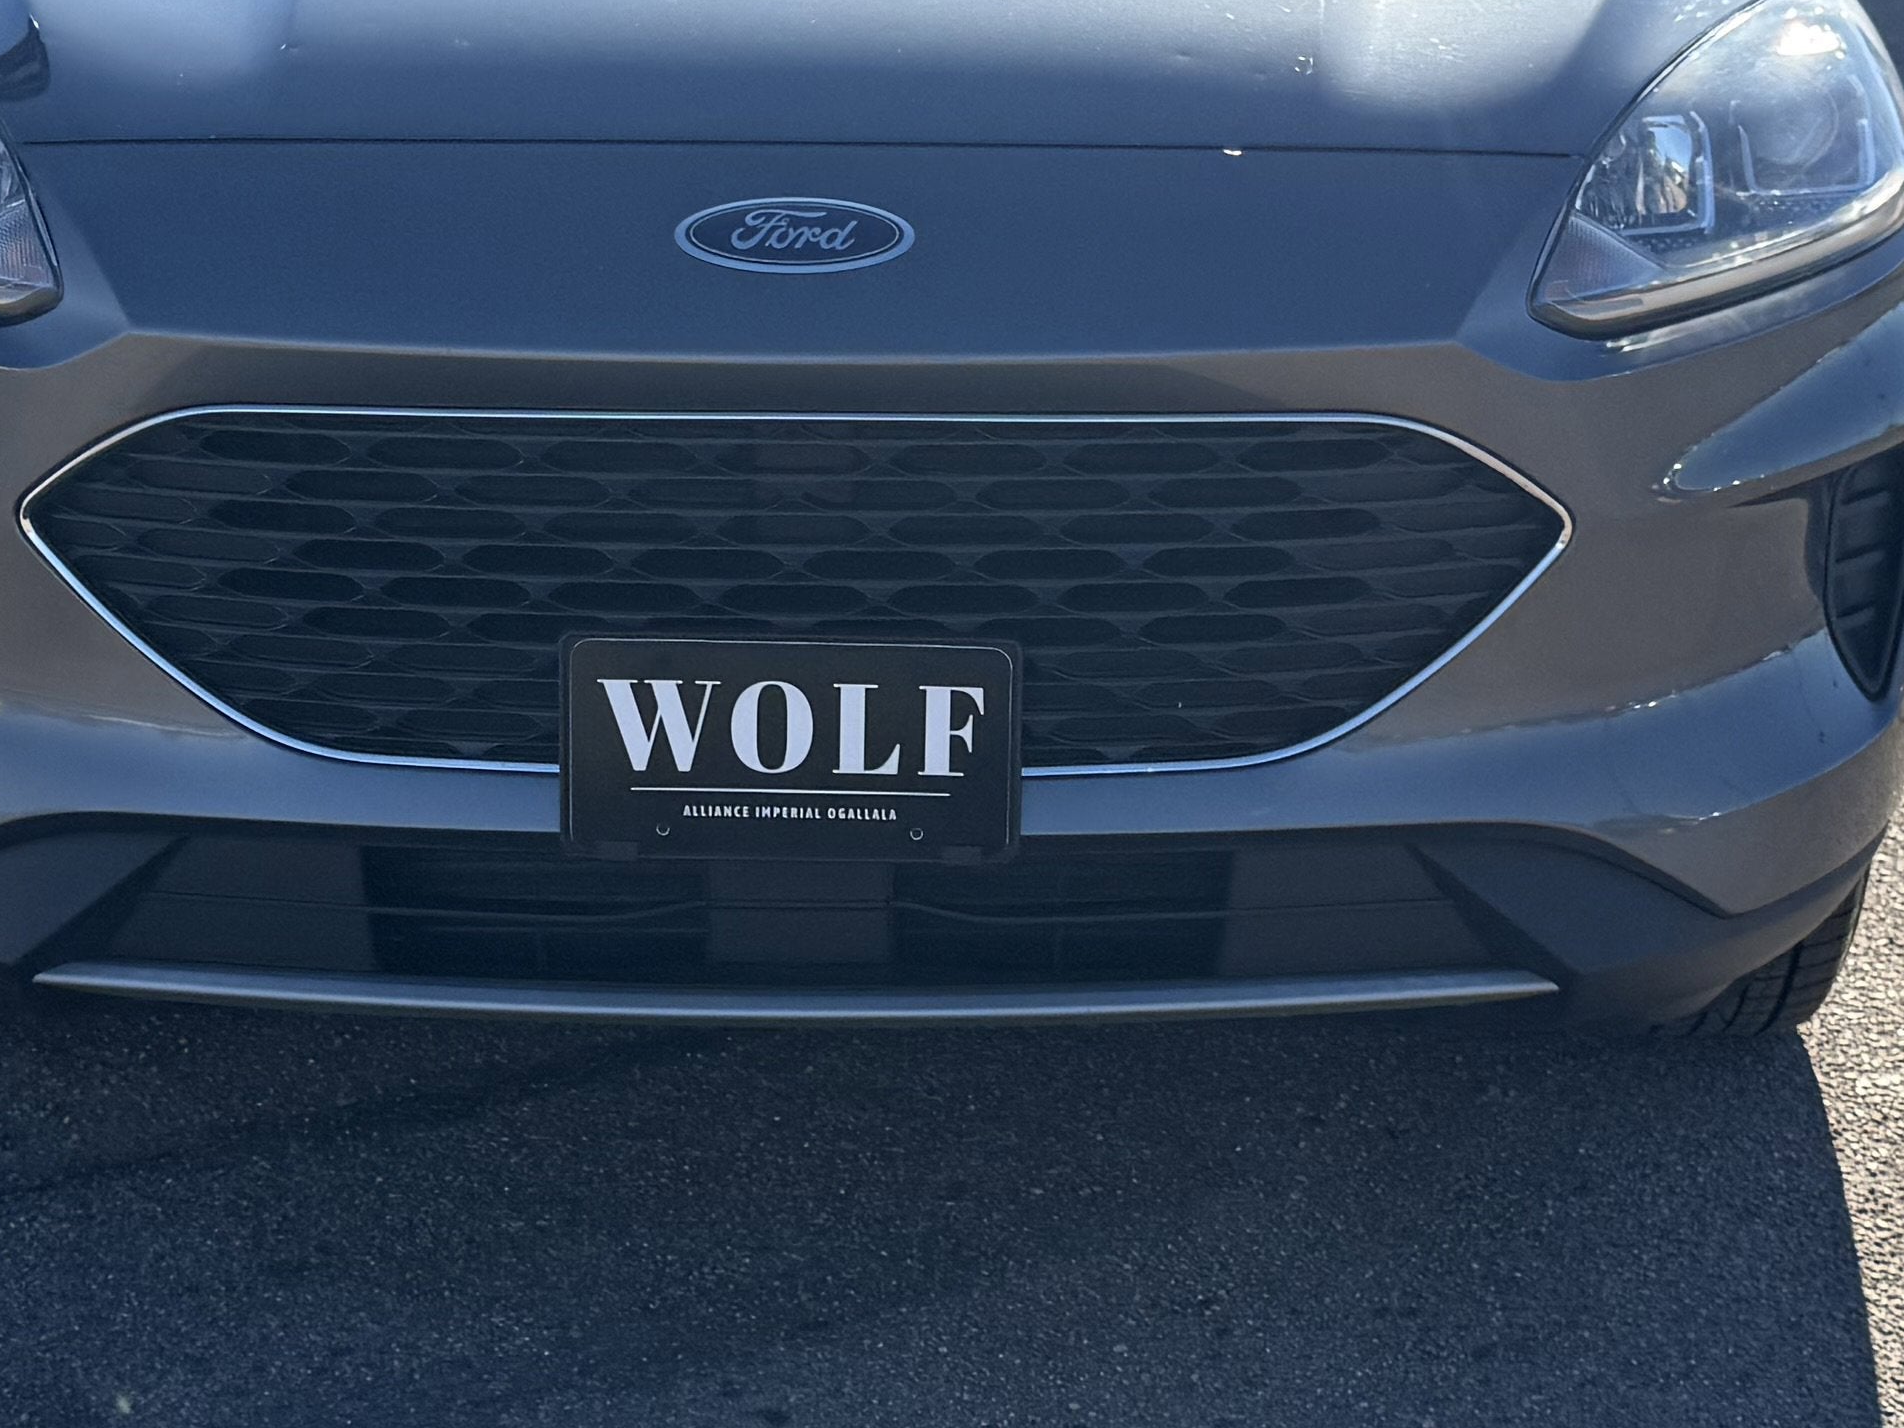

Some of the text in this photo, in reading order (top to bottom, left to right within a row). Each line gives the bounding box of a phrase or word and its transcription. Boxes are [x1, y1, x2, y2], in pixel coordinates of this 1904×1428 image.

[730, 208, 858, 251] Ford
[596, 678, 985, 777] WOLF
[683, 804, 898, 821] ALLIANCE IMPERIAL OGALLALA
